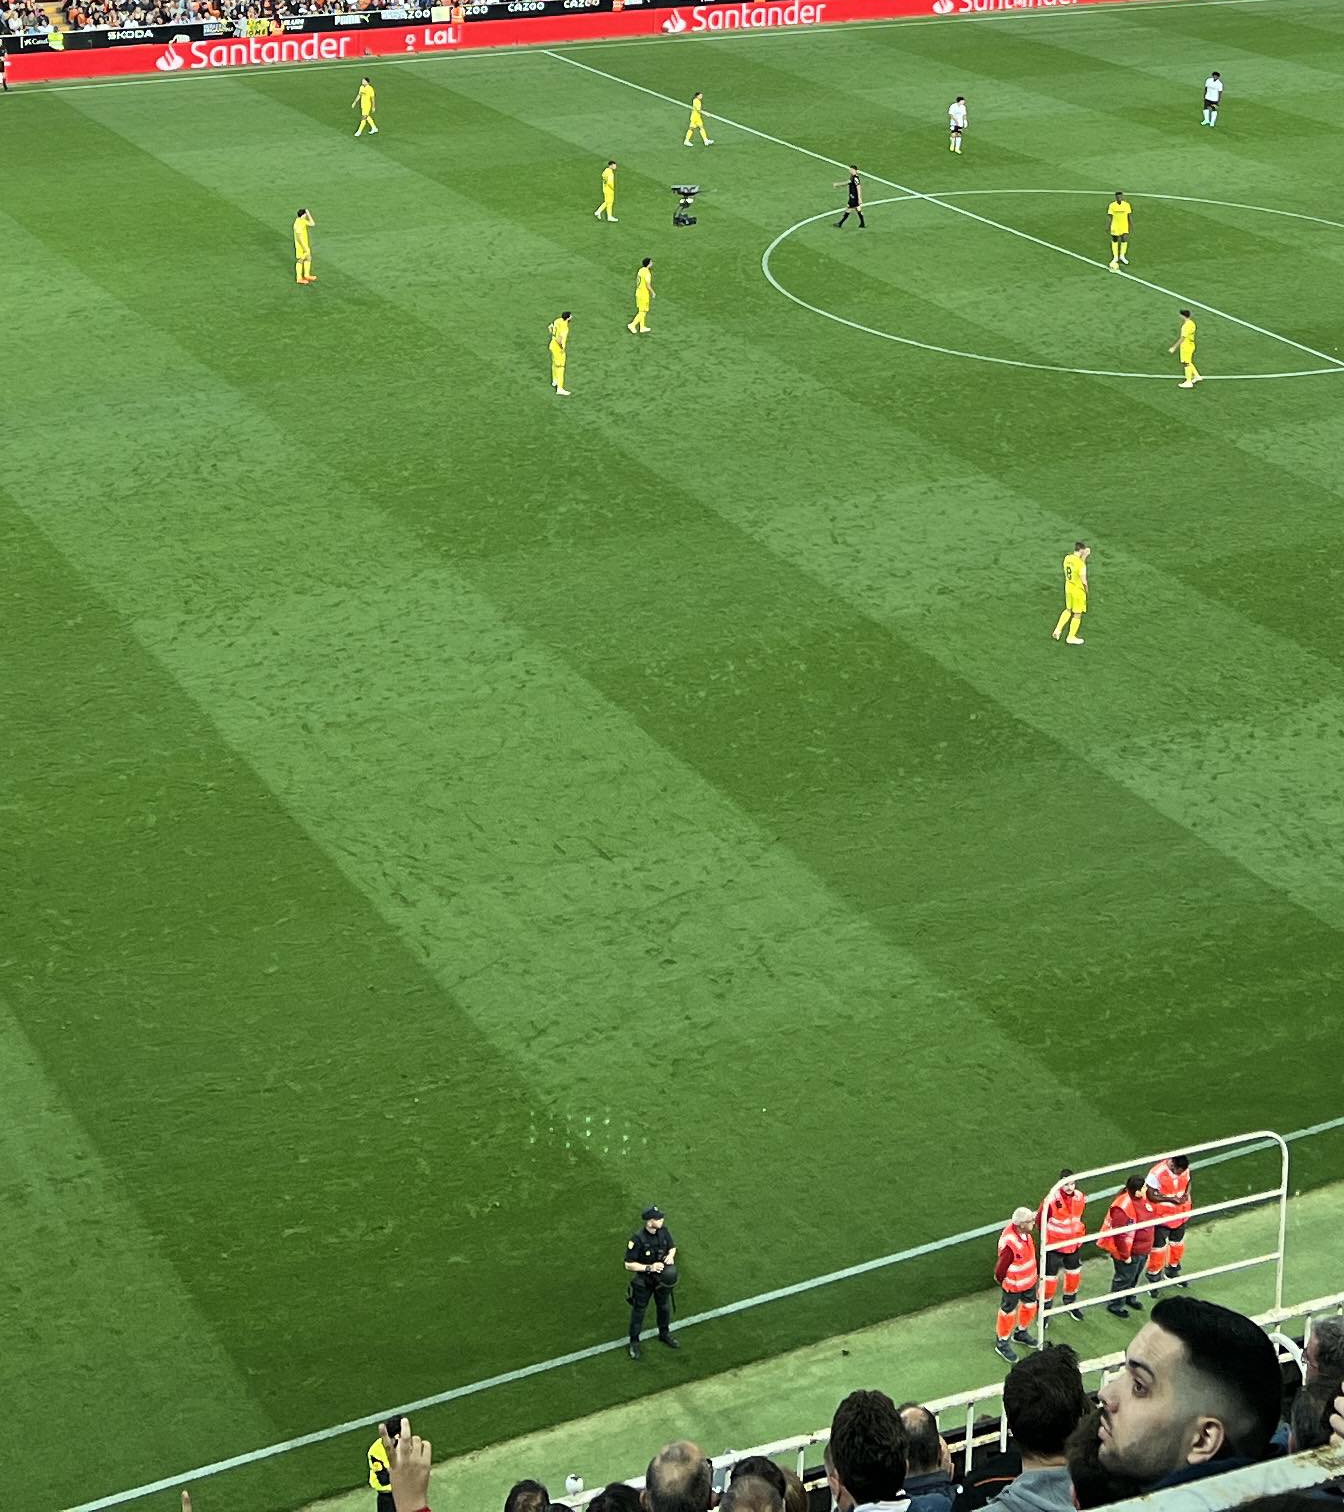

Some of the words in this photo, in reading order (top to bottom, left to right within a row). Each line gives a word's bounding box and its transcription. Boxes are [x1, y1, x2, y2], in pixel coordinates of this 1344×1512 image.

[508, 1, 545, 12] CAZOO
[691, 0, 826, 32] Santander
[107, 29, 154, 40] SKODA
[191, 33, 350, 69] Santander
